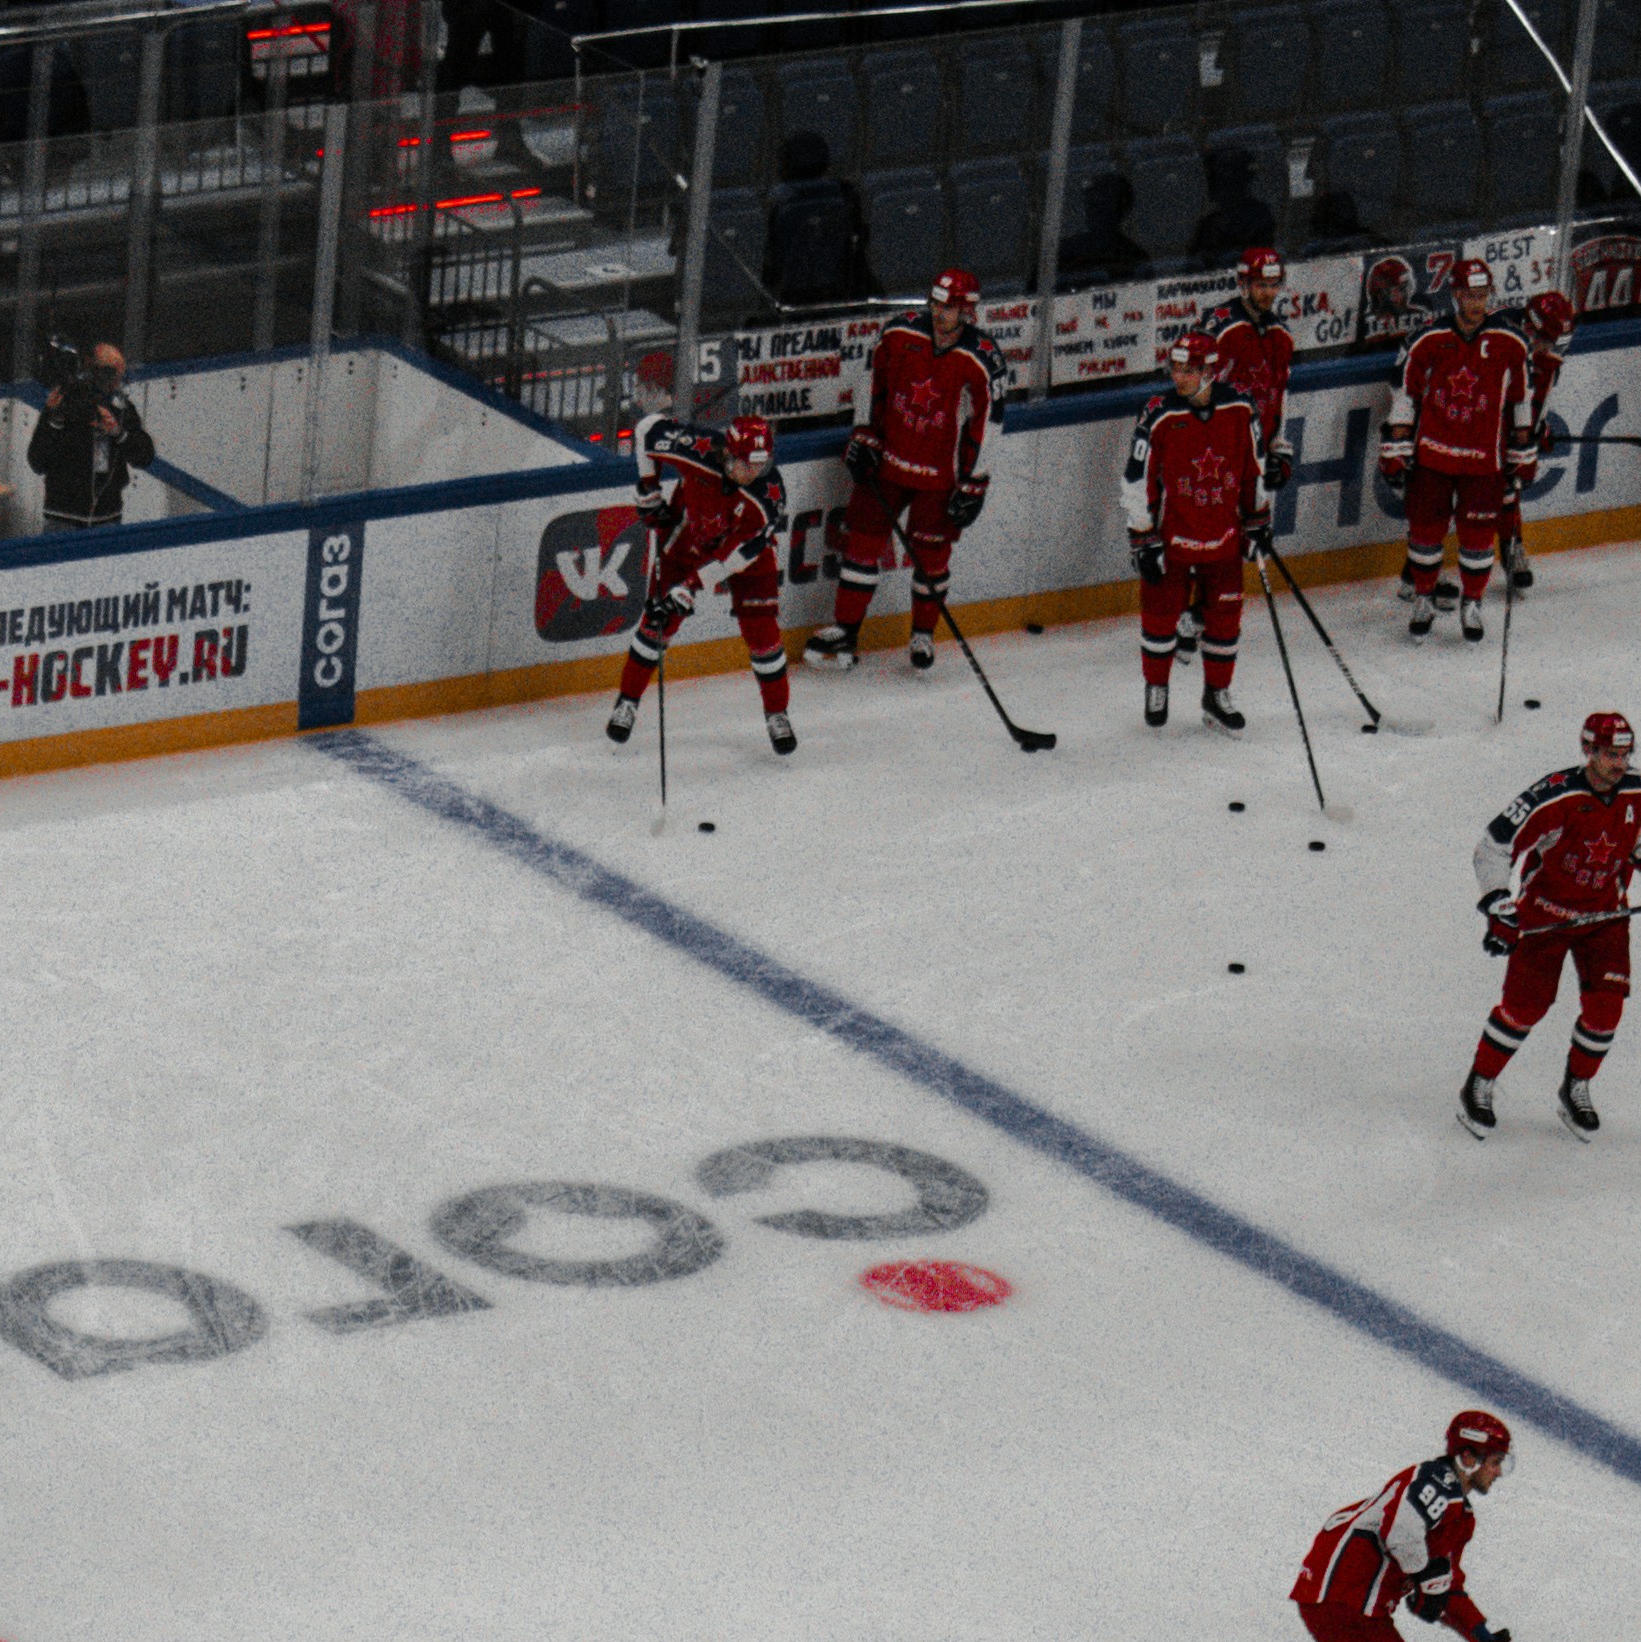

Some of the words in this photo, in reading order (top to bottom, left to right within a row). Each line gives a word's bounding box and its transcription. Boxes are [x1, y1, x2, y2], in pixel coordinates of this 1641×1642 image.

[1485, 236, 1536, 263] BEST
[1314, 308, 1352, 343] GO!
[166, 579, 252, 624] МАТЧ:
[1418, 1483, 1449, 1521] 88
